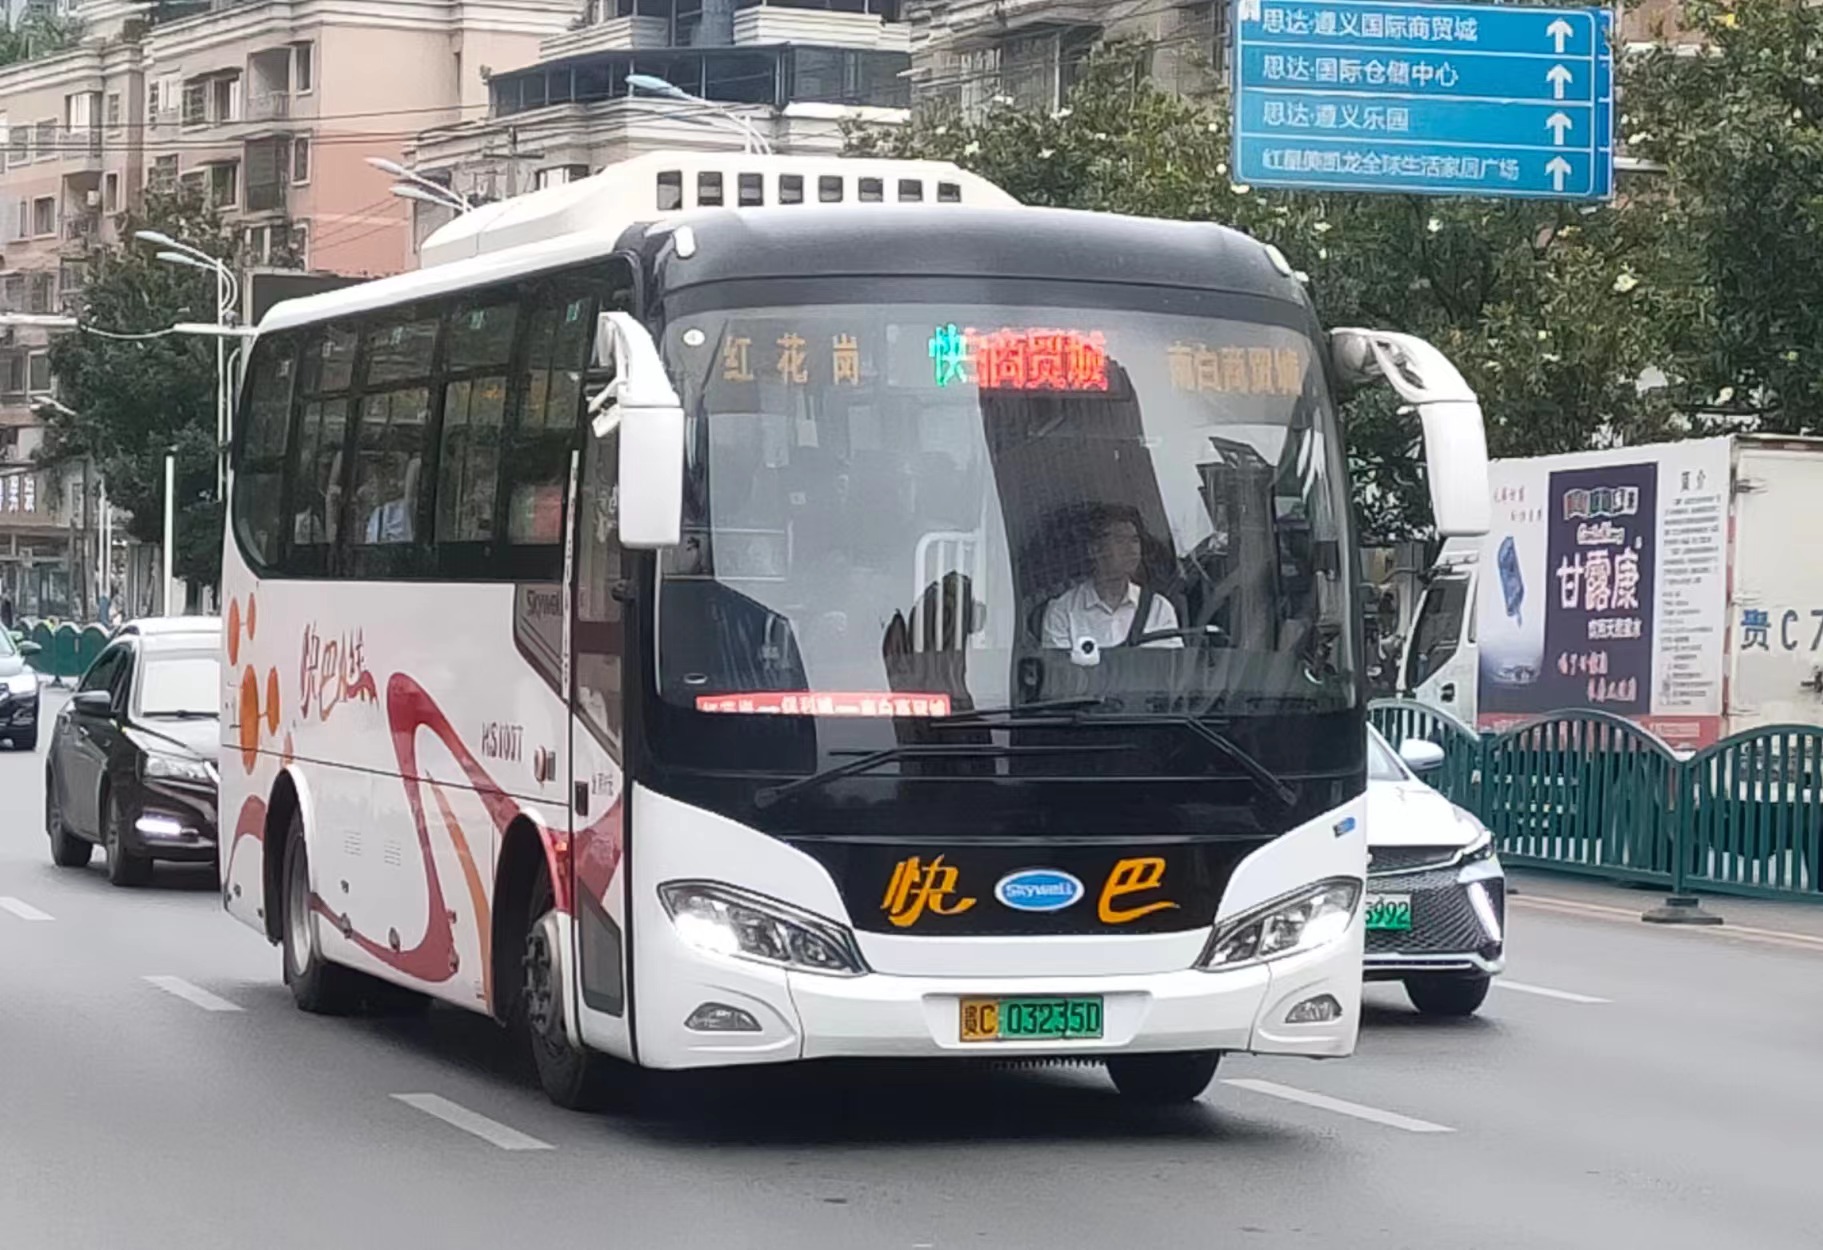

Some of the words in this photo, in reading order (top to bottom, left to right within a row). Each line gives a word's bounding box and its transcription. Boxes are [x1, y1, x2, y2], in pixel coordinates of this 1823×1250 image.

[1262, 55, 1459, 88] 思达·国际仓储中心
[723, 332, 859, 386] 红花岗
[1556, 546, 1640, 612] 甘露康
[880, 853, 977, 928] 快
[1098, 857, 1181, 924] 巴
